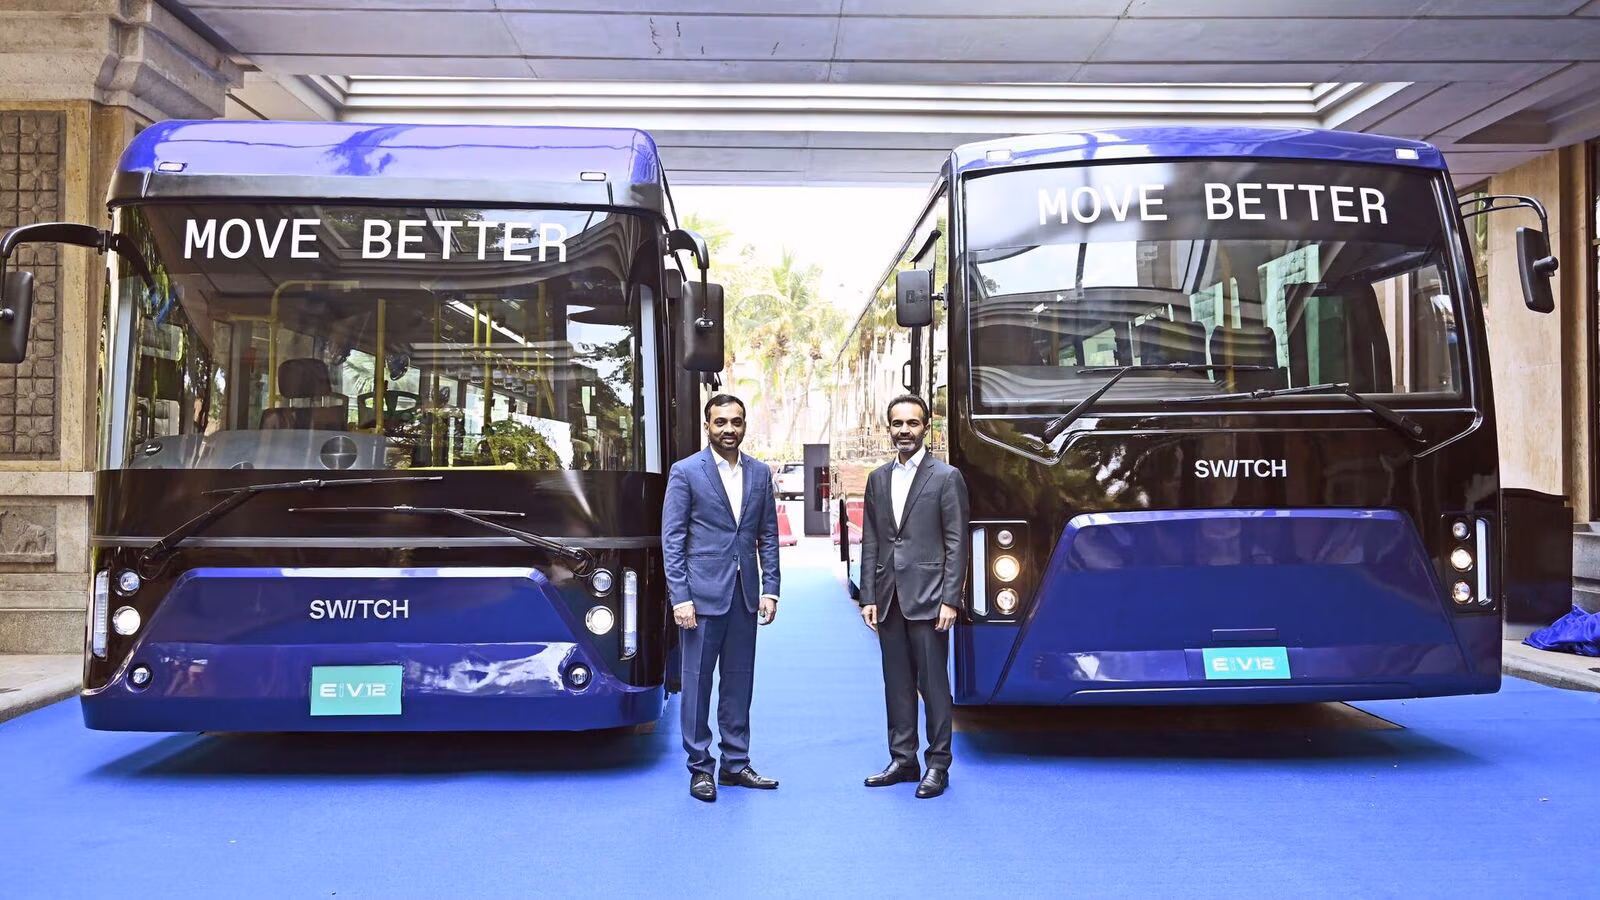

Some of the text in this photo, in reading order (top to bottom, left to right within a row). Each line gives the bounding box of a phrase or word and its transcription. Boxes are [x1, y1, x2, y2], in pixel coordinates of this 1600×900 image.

[1038, 183, 1388, 225] MOVE BETTER
[184, 218, 567, 263] MOVE BETTER
[1194, 459, 1287, 478] SWITCH
[309, 599, 409, 619] SWITCH
